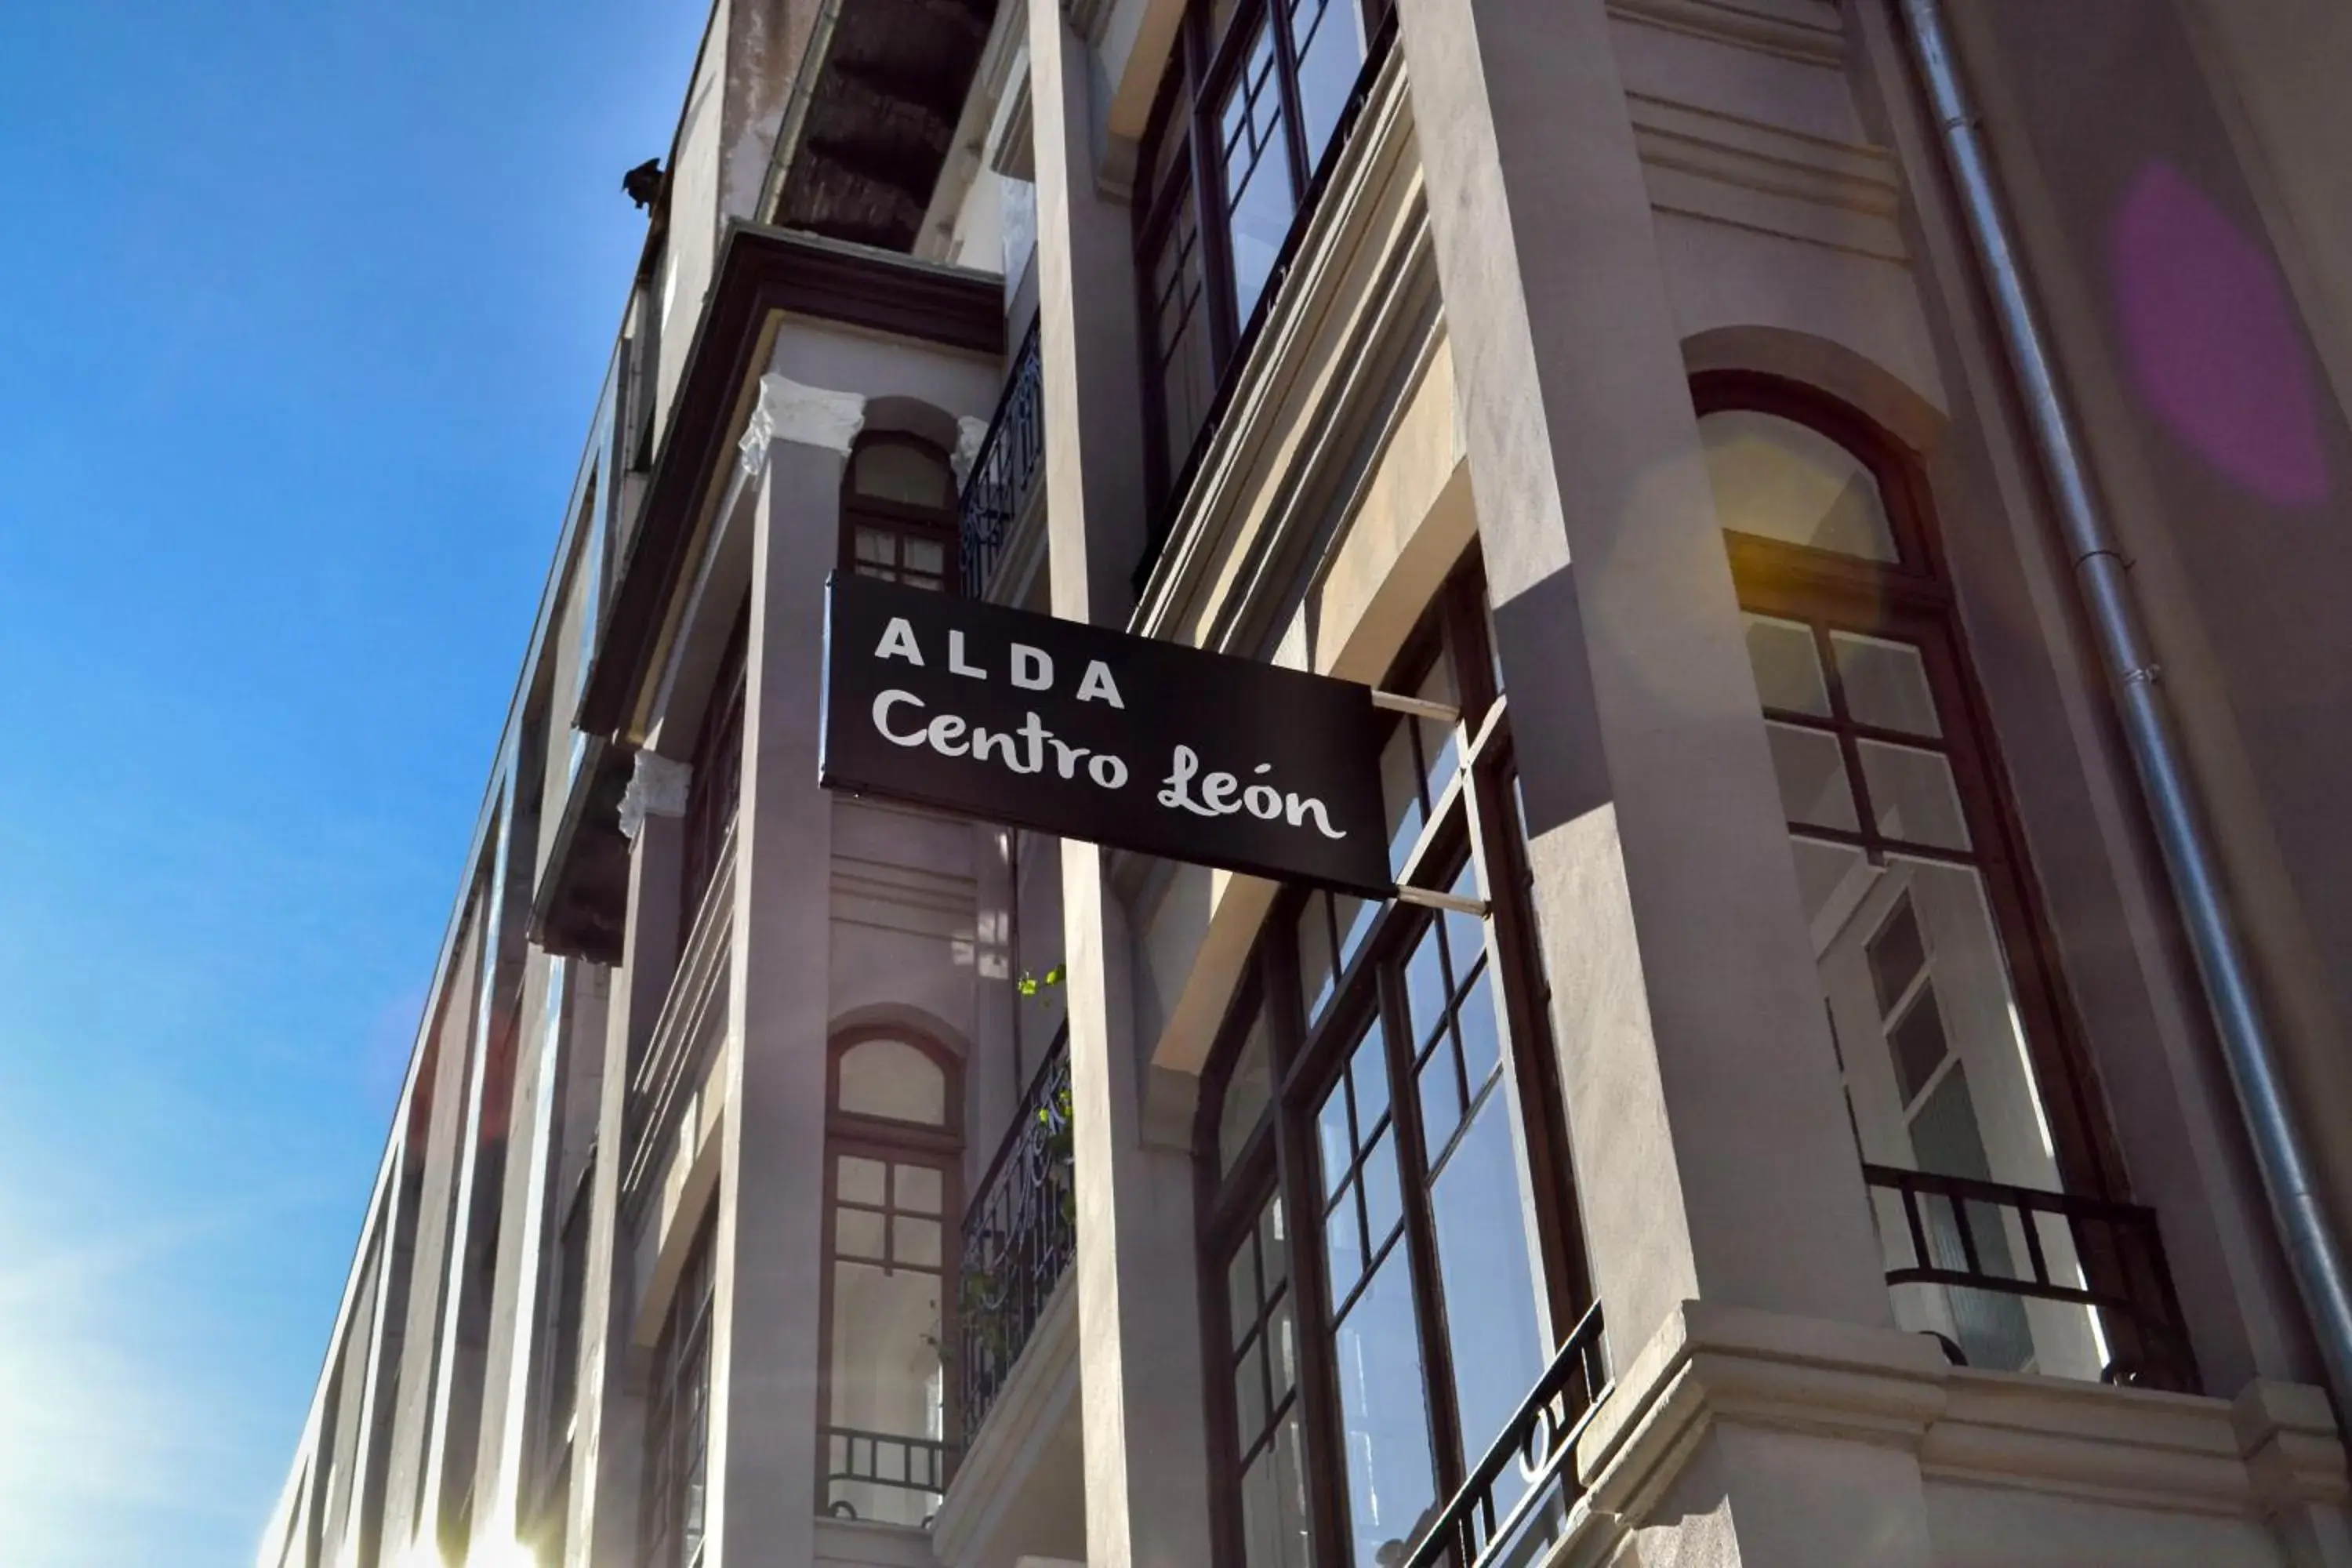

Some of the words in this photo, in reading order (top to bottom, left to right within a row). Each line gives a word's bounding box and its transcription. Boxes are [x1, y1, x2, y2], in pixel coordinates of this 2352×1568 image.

[874, 617, 1125, 709] ALDA
[872, 688, 1128, 789] Centro
[1156, 744, 1347, 839] León
